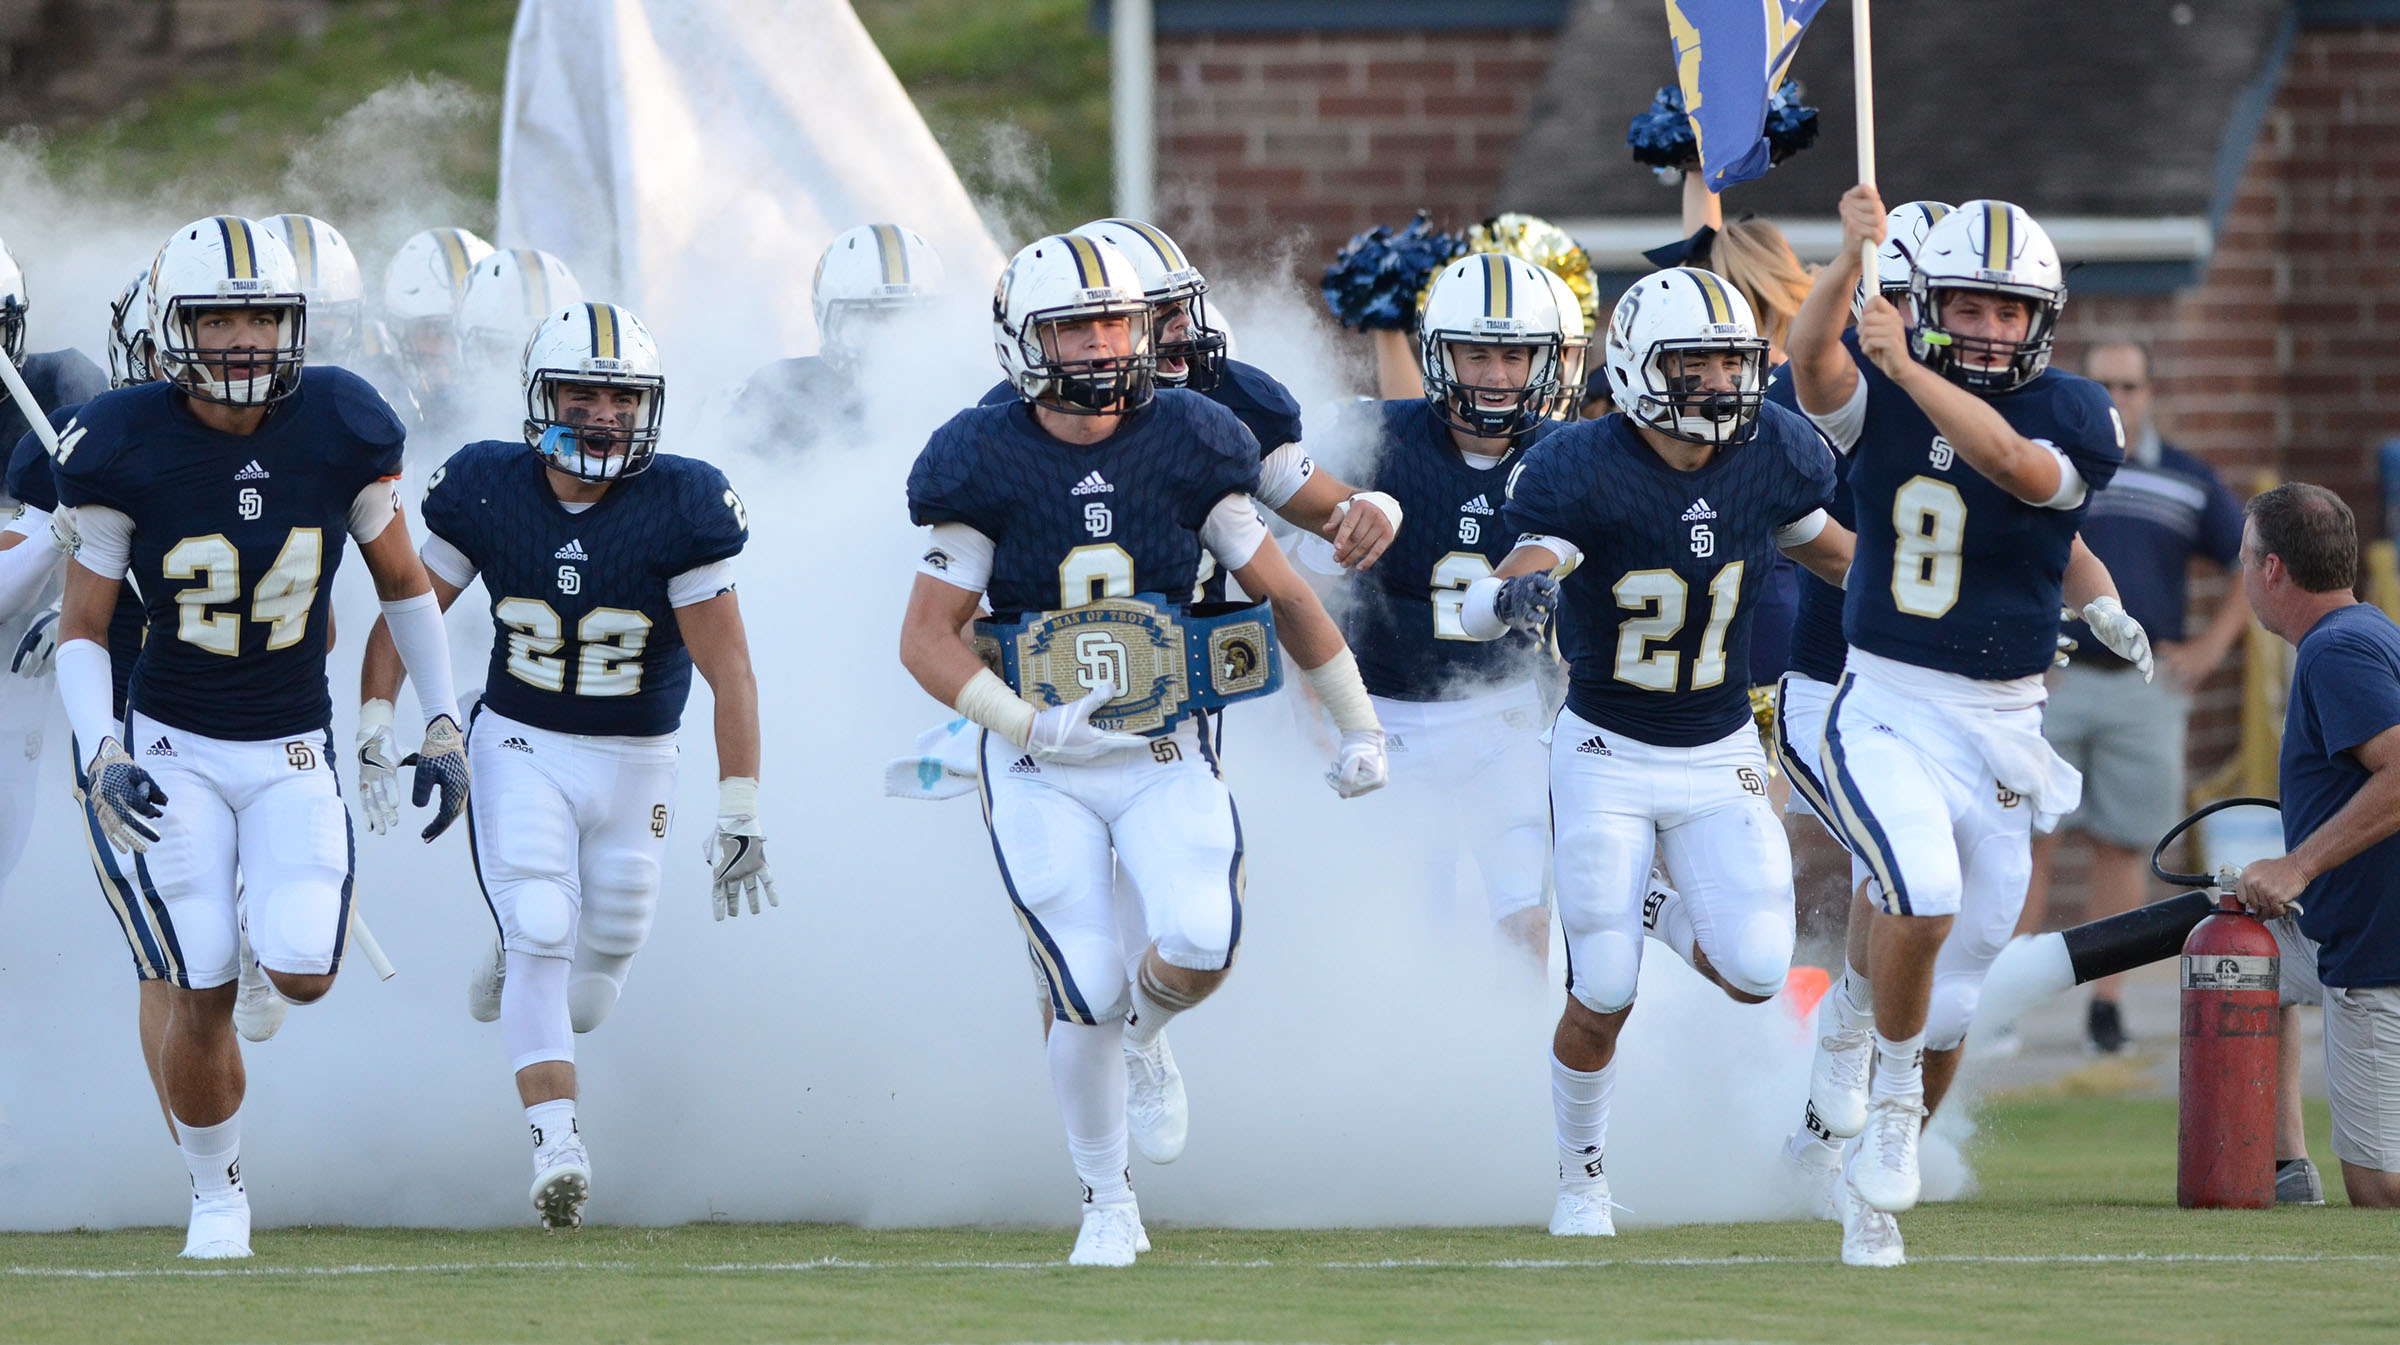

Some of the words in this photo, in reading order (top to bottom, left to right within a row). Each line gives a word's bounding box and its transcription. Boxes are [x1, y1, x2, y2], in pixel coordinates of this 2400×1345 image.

[232, 281, 258, 290] TROJANS
[1086, 289, 1112, 300] TROJANS
[1486, 320, 1511, 330] TROJANS
[1713, 324, 1736, 334] TROJANS
[594, 360, 619, 370] TROJANS
[1929, 435, 1955, 472] SD
[239, 488, 263, 520] SD
[1084, 502, 1113, 538] SD
[1458, 516, 1481, 545] SD
[1690, 524, 1715, 558] SD
[1891, 474, 1968, 620] 8
[163, 527, 322, 658] 24
[557, 565, 581, 595] SD
[1052, 613, 1080, 629] MAN
[1086, 611, 1103, 621] OF
[1109, 612, 1147, 625] TROY
[1612, 560, 1745, 692] 21
[496, 596, 654, 697] 22
[1075, 630, 1130, 698] SD
[286, 741, 315, 770] SD
[1736, 767, 1765, 796] SD
[651, 804, 668, 838] SD
